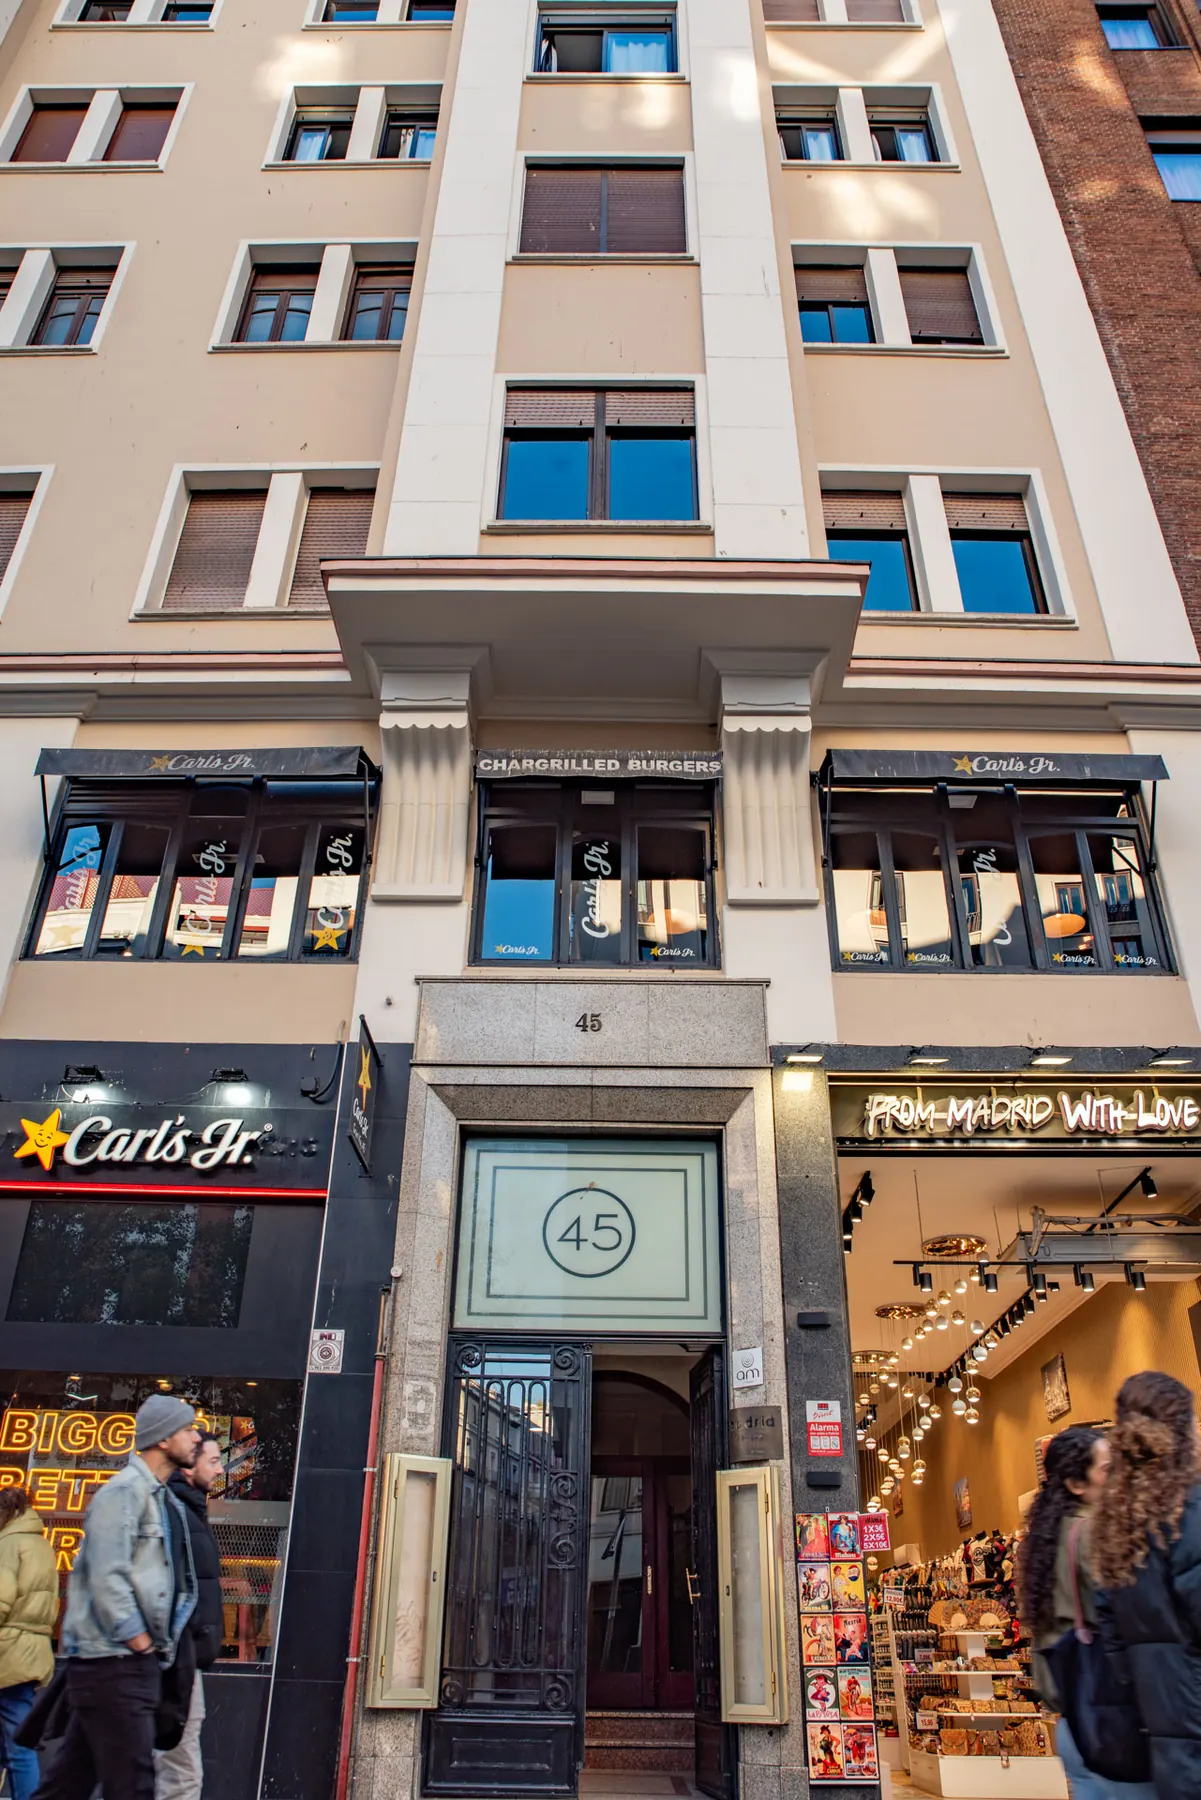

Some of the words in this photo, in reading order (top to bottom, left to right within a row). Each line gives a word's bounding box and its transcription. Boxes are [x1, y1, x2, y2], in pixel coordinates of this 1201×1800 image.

[168, 754, 223, 770] Carl's
[223, 753, 255, 771] Jr.
[479, 758, 620, 771] CHARGRILLED
[627, 759, 722, 773] BURGERS
[972, 756, 1027, 772] Carl's
[1028, 757, 1060, 773] Jr.
[575, 1013, 603, 1032] 45
[867, 1096, 935, 1136] FROM
[946, 1095, 1052, 1133] MADRID
[1061, 1092, 1128, 1130] WITH
[1137, 1092, 1200, 1129] LOVE
[63, 1115, 192, 1167] Carl's
[557, 1213, 622, 1251] 45
[810, 1423, 839, 1432] Alarma
